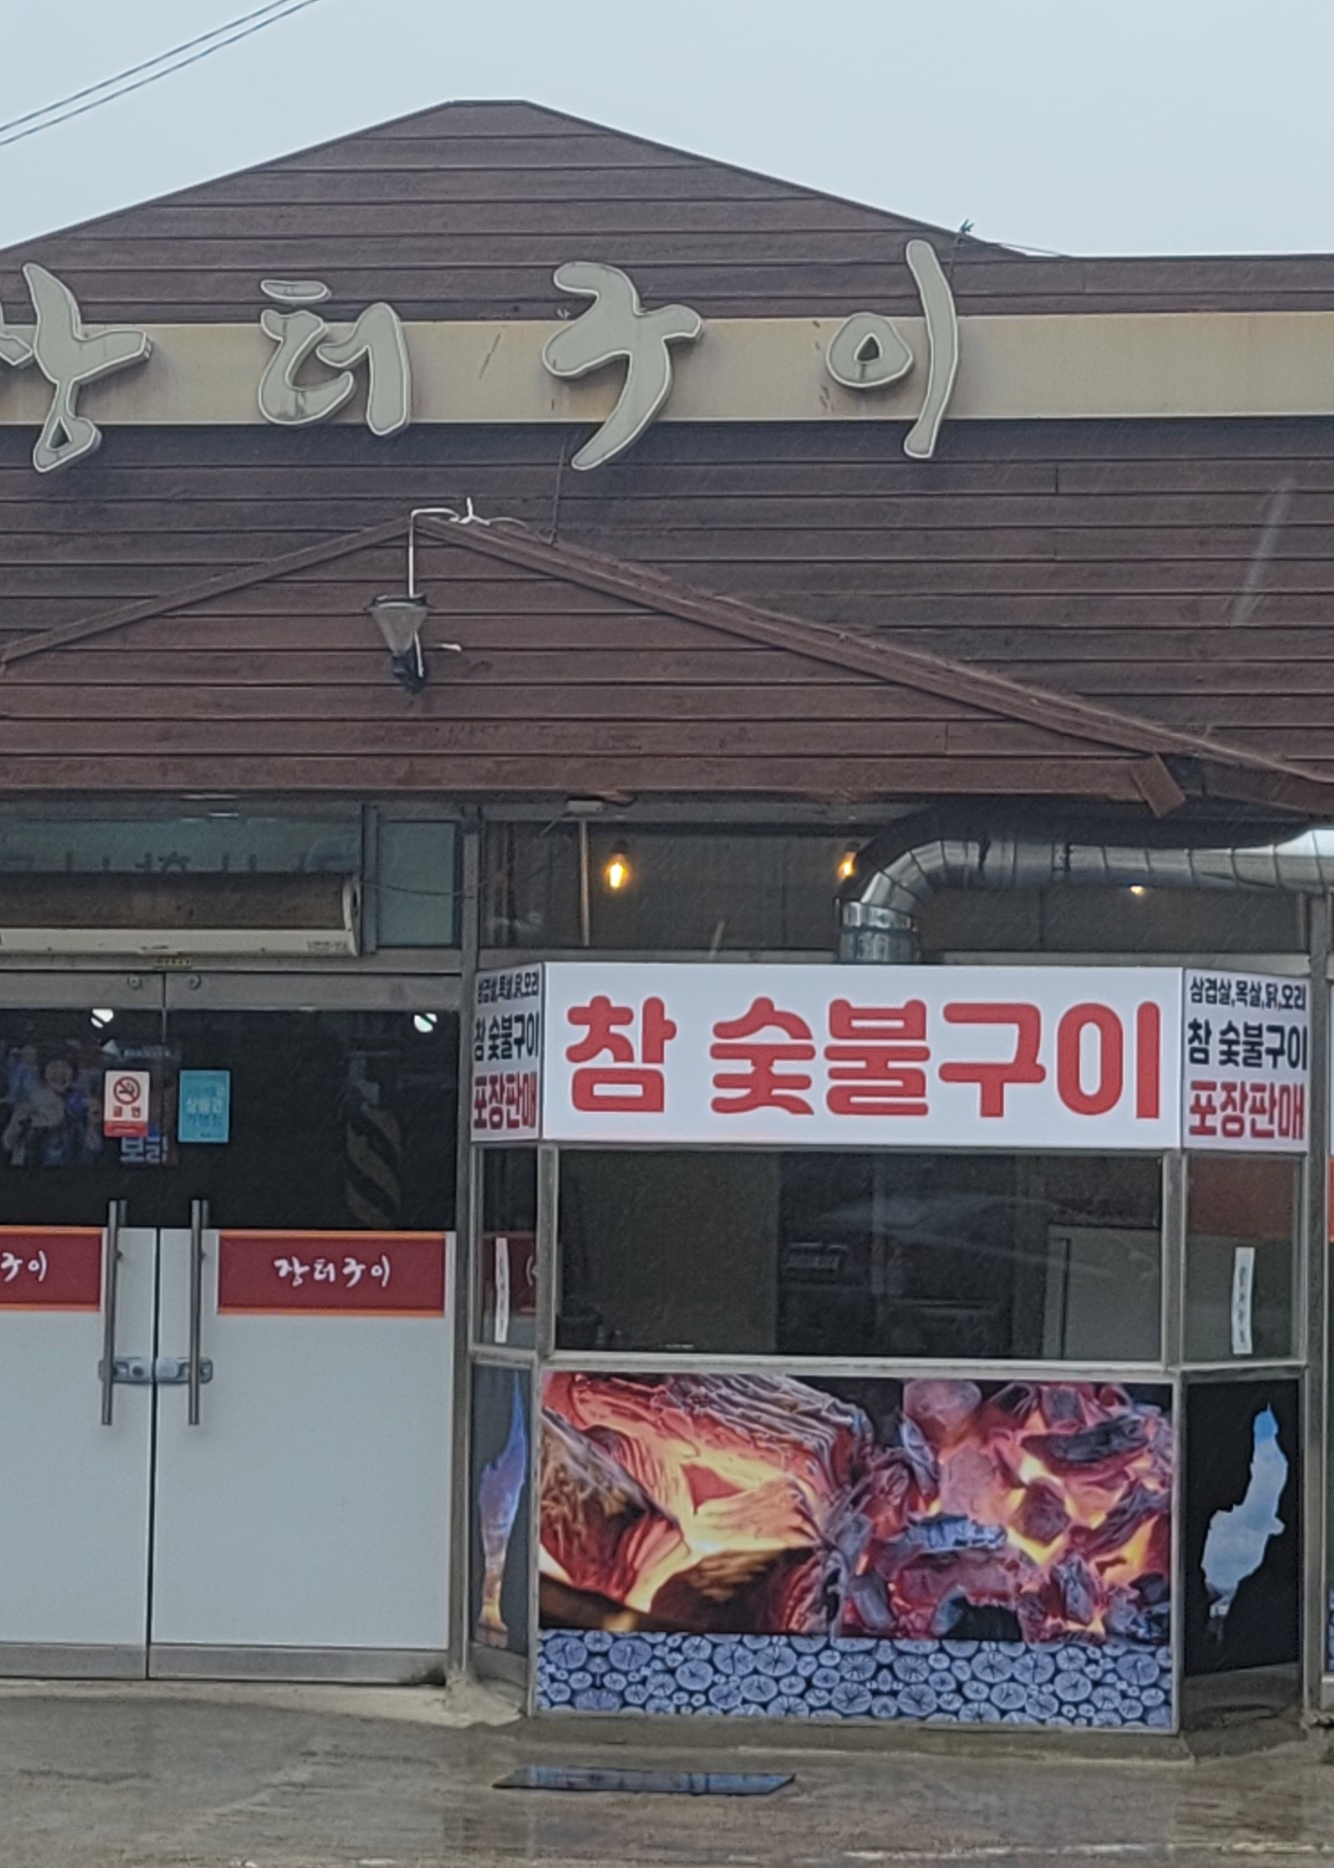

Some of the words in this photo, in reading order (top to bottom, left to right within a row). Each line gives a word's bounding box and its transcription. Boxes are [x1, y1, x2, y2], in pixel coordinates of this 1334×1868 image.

[488, 1012, 538, 1061] 숯불구이
[567, 997, 676, 1112] 참
[711, 998, 1160, 1118] 숯불구이
[1188, 1017, 1212, 1065] 참
[1218, 1020, 1307, 1070] 숯불구이
[473, 1072, 538, 1128] 포장판매
[1189, 1080, 1305, 1139] 포장판매
[274, 1256, 389, 1287] 장터구이
